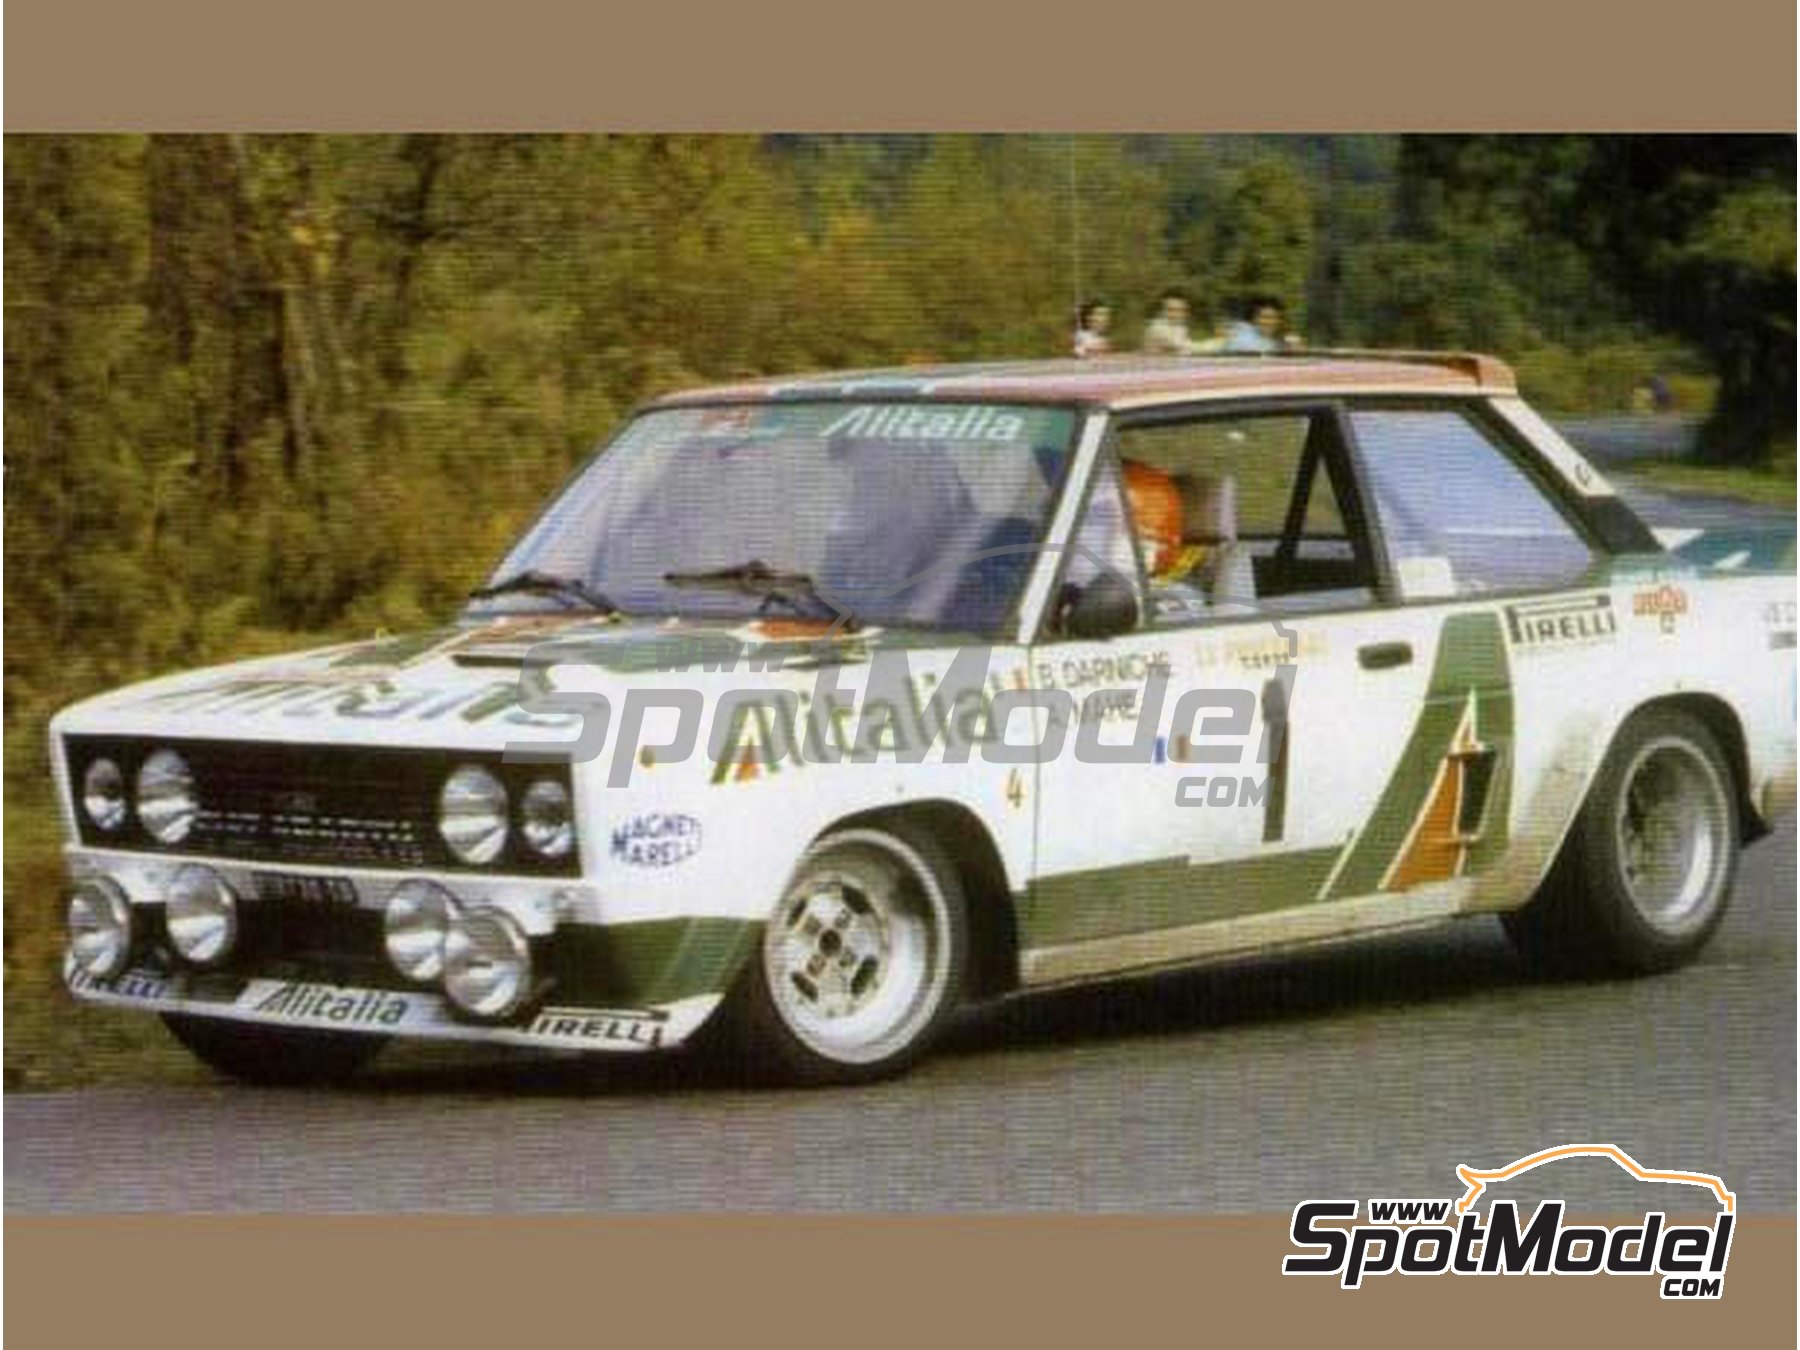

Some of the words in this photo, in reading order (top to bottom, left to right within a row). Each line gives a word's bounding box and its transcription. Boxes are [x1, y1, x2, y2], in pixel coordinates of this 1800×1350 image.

[819, 404, 1024, 441] Alitalia
[1504, 594, 1617, 644] PIRELLI
[710, 666, 1004, 785] Alitalia
[1006, 767, 1025, 808] 4
[255, 978, 408, 1025] Alitalia
